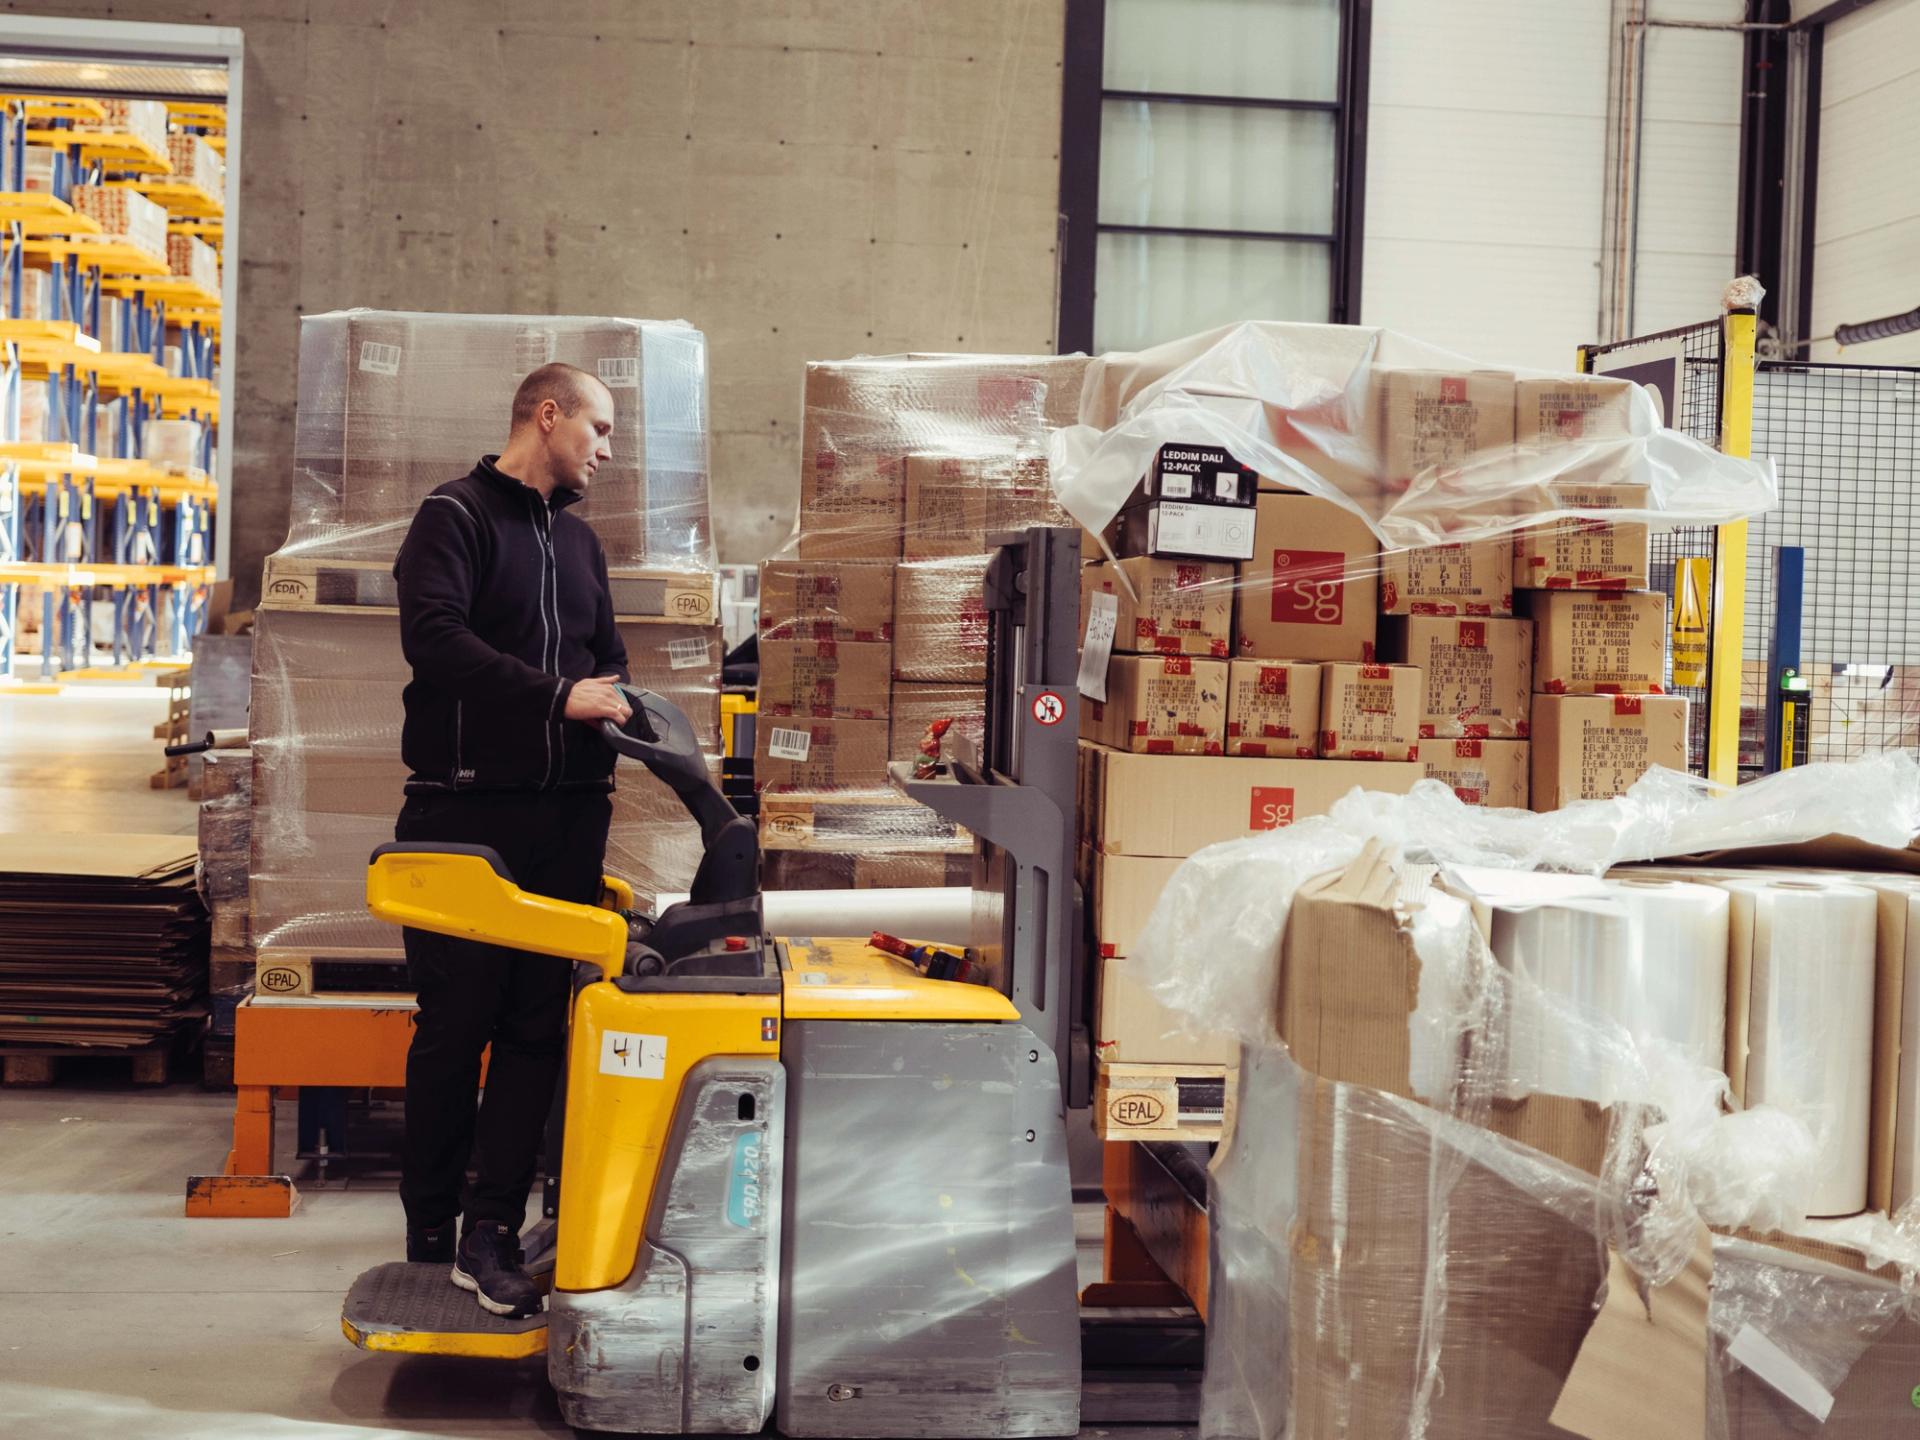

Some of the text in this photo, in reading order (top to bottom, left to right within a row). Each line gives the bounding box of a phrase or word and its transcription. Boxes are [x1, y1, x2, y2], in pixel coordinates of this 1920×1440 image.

[1163, 450, 1223, 463] LEDDIM DALI
[1163, 462, 1201, 472] 12-PACK
[677, 598, 703, 612] EPAL
[1293, 580, 1340, 622] sg
[1617, 647, 1629, 655] PCS
[1620, 752, 1632, 760] 517
[1263, 804, 1292, 829] sg
[267, 973, 294, 986] EPAL
[614, 1038, 643, 1068] 41
[1118, 1102, 1156, 1119] EPAL
